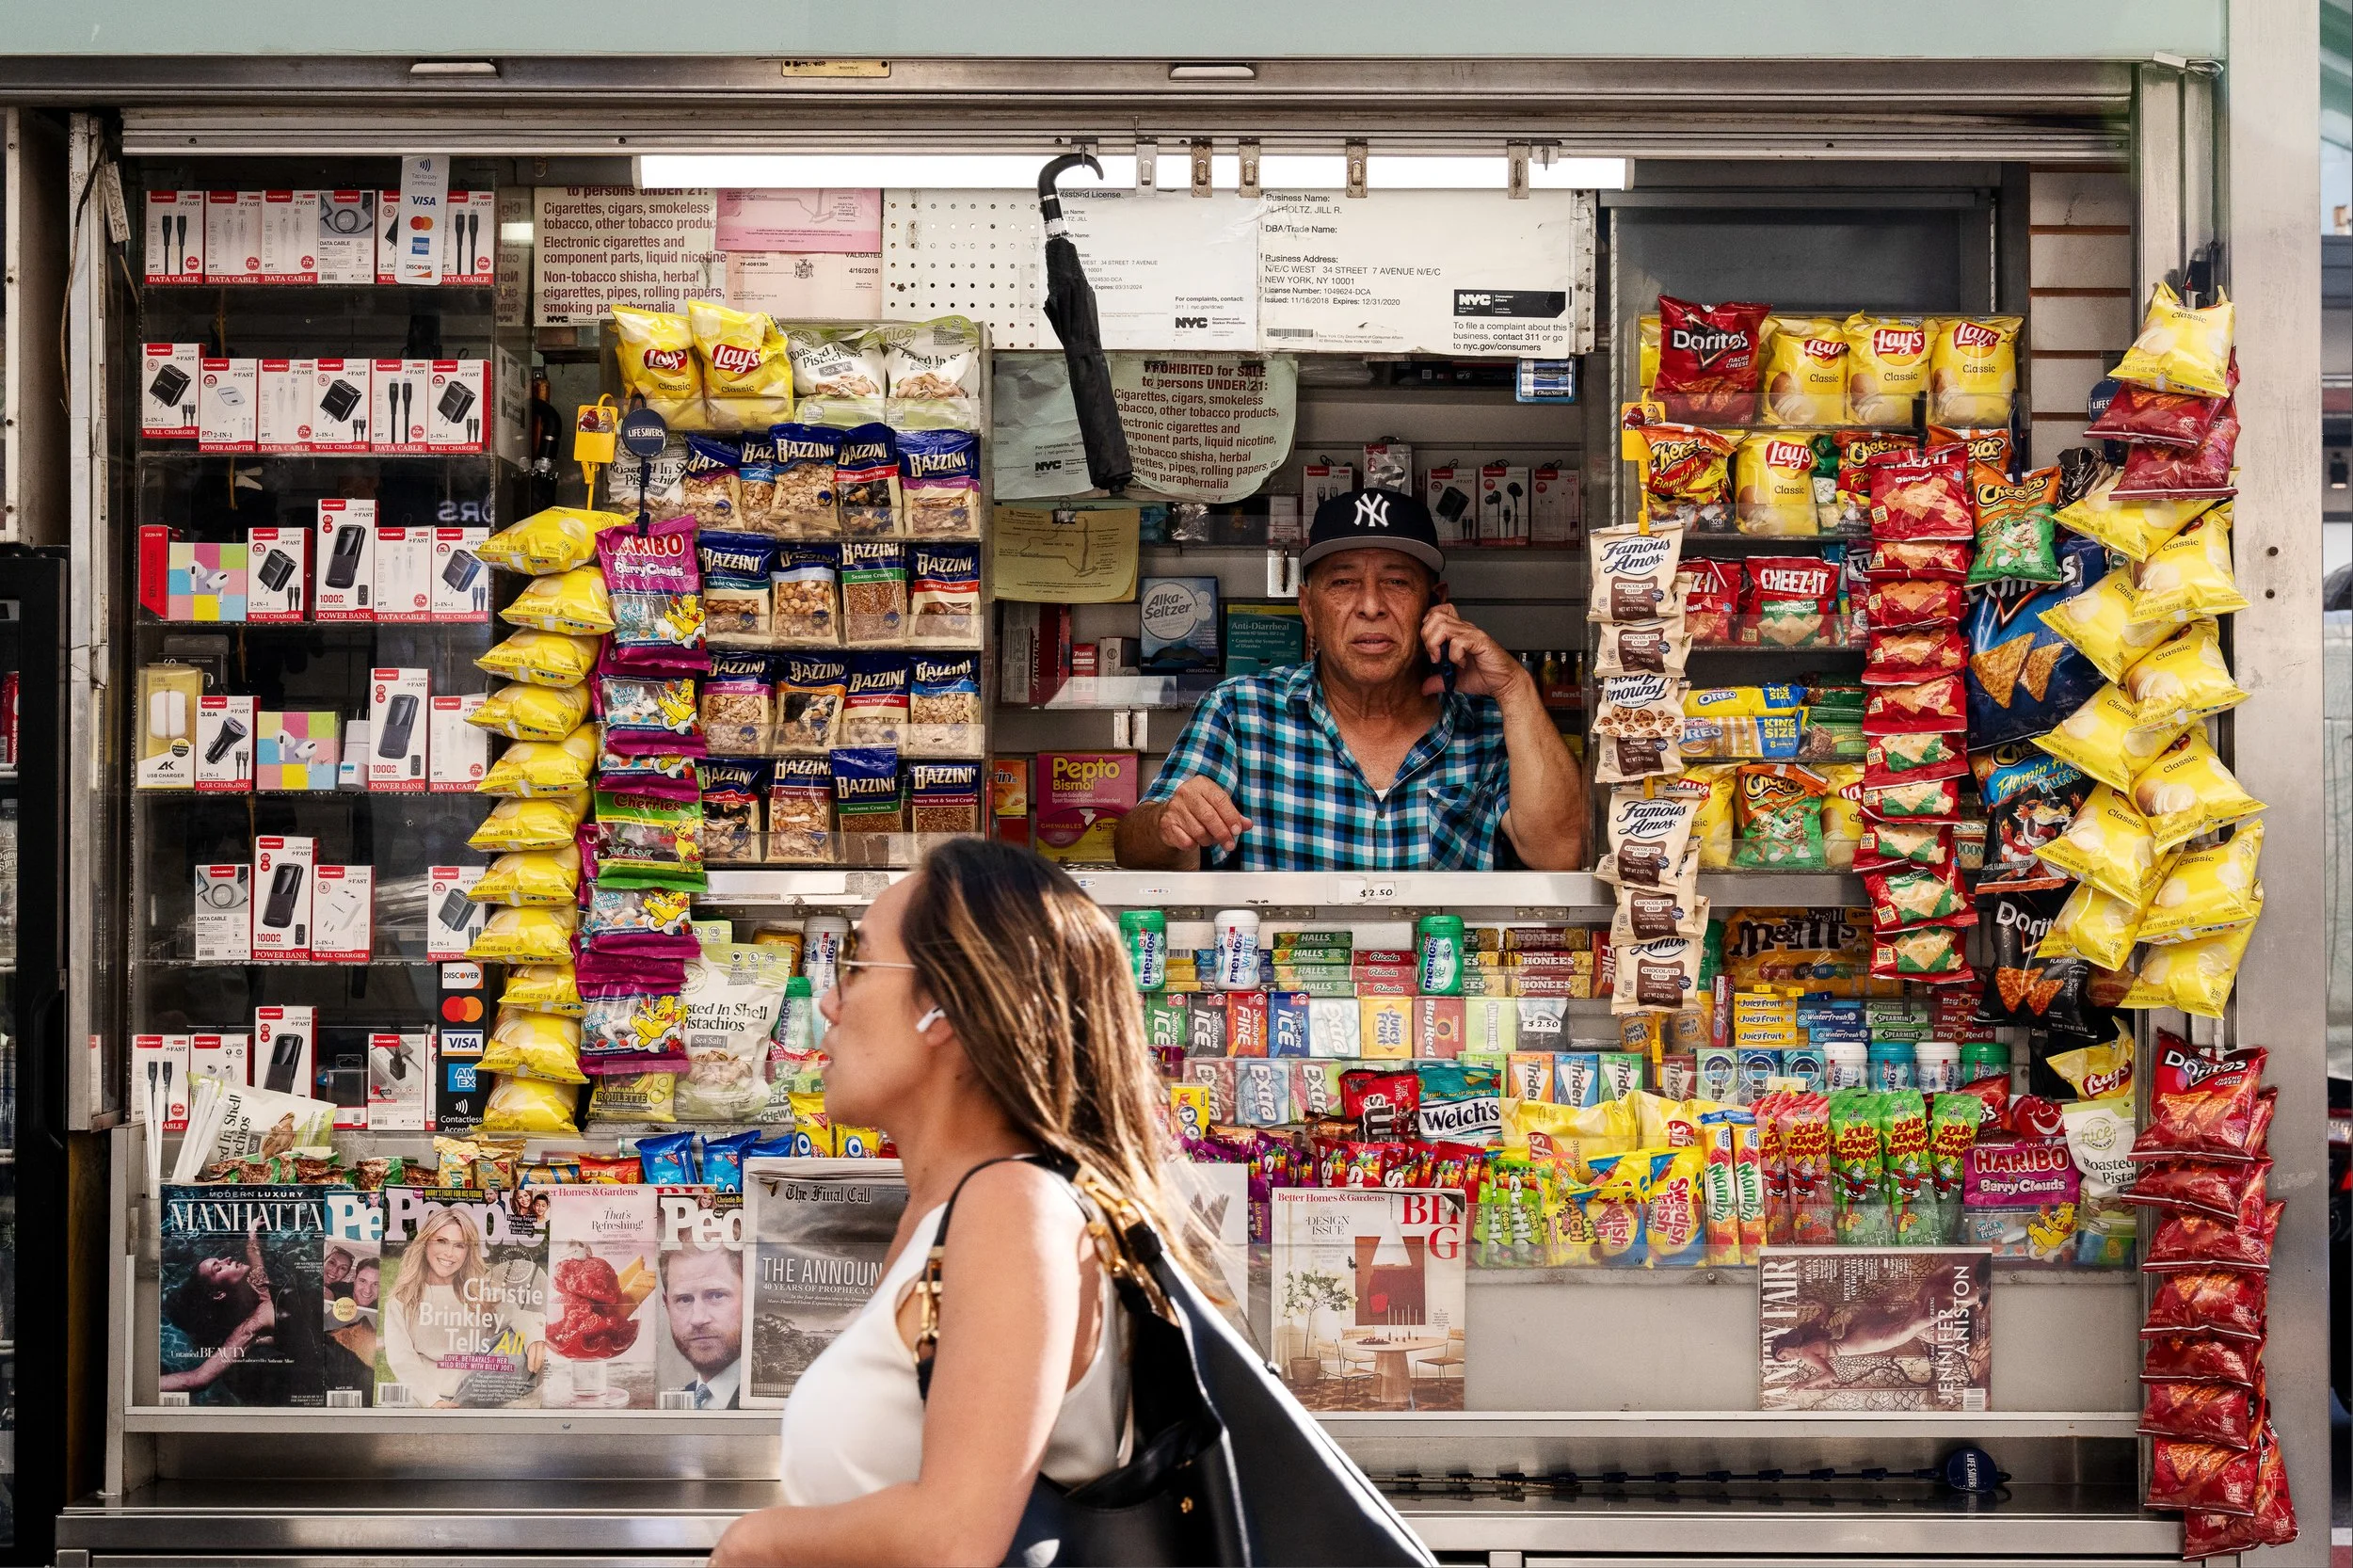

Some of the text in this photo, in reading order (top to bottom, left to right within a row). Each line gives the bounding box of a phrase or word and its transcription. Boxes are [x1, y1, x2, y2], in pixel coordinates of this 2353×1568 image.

[411, 195, 436, 206] VISA
[544, 202, 710, 216] Cigarettes, cigars, smokeless
[1288, 277, 1314, 285] YORK,
[544, 287, 603, 299] cigarettes,
[607, 287, 640, 299] pipes,
[644, 287, 679, 299] rolling
[683, 287, 725, 300] papers,
[1459, 295, 1491, 305] NYC
[1176, 317, 1208, 328] NYC
[2171, 311, 2207, 324] Classic
[1487, 323, 1526, 331] complaint
[1464, 343, 1541, 351] nyc.gov/consumers
[1673, 331, 1749, 350] Doritos
[1884, 373, 1917, 381] Classic
[1114, 389, 1263, 405] Cigarettes, cigars, smokeless
[777, 439, 834, 462] BAZZINI
[909, 452, 967, 477] BAZZINI
[1354, 493, 1391, 527] NY
[1600, 539, 1671, 561] Famous
[1604, 554, 1660, 573] Amos
[1760, 569, 1829, 595] CHEEZ-IT
[1150, 594, 1183, 606] Alka-
[1144, 602, 1192, 620] Seltzer
[852, 669, 905, 694] BAZZINI
[1698, 692, 1737, 705] OREO
[1764, 719, 1795, 728] KING
[1766, 727, 1796, 738] SIZE
[1053, 758, 1120, 780] Pepto
[2163, 754, 2198, 774] Classic
[837, 776, 895, 799] BAZZINI
[1053, 779, 1094, 791] Bismol
[1997, 761, 2049, 800] Flamin'
[2037, 769, 2081, 793] Puffs
[1230, 933, 1242, 984] mentos
[1424, 938, 1437, 989] mentos
[1524, 957, 1574, 966] HONEES
[1602, 944, 1616, 984] FIRE
[1762, 999, 1781, 1007] Fruit
[1807, 1013, 1848, 1021] Winterfresh
[1194, 1009, 1212, 1047] ICE
[1212, 1011, 1221, 1048] Dentyne
[1377, 1012, 1389, 1045] Fruit
[1389, 1011, 1401, 1045] Juicy
[449, 1037, 478, 1048] VISA
[455, 1068, 475, 1078] AM
[2165, 1050, 2248, 1078] Doritos
[458, 1077, 475, 1087] EX
[597, 1093, 647, 1103] ROULETTE
[440, 1115, 482, 1124] Contactless
[1422, 1101, 1500, 1131] Welch's
[1844, 1126, 1873, 1139] SOUR
[1839, 1138, 1877, 1150] POWER
[1974, 1148, 2070, 1174] HARIBO
[786, 1183, 871, 1203] The Final Call
[1708, 1162, 1728, 1223] Mamba
[1979, 1177, 2066, 1195] Berry Clouds
[1278, 1193, 1305, 1202] Better
[1306, 1193, 1337, 1202] Homes
[1347, 1193, 1385, 1202] Gardens
[171, 1203, 324, 1232] MANHATTA
[603, 1209, 631, 1219] That's
[1307, 1216, 1350, 1224] DESIGN
[592, 1221, 644, 1232] Refreshing!
[1312, 1226, 1344, 1235] ISSUE
[762, 1257, 794, 1283] THE
[464, 1278, 543, 1304] Christie
[773, 1283, 803, 1291] YEARS
[819, 1286, 869, 1295] PROPHECY,
[1763, 1260, 1798, 1319] FAIR
[420, 1303, 504, 1334] Brinkley
[1954, 1265, 1969, 1356] ANISTON
[445, 1329, 524, 1354] Tells All
[1938, 1309, 1954, 1404] JENNIFER
